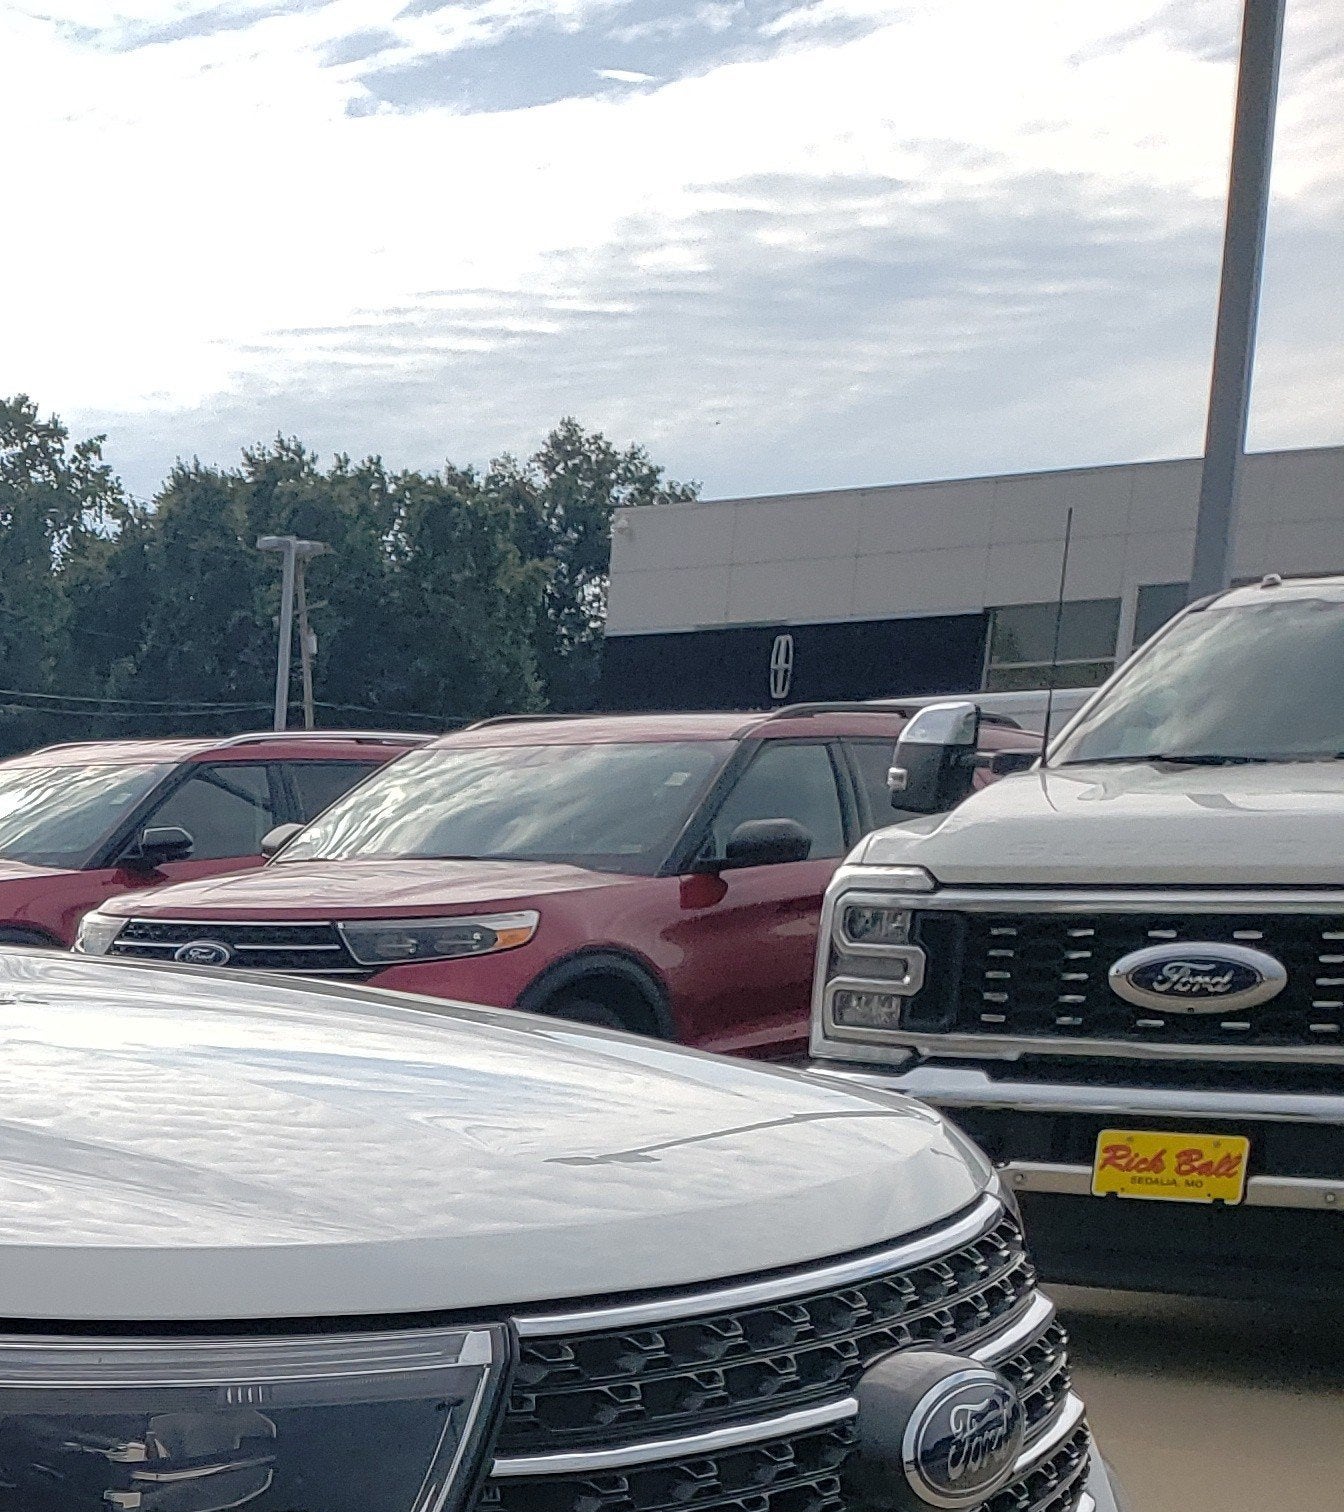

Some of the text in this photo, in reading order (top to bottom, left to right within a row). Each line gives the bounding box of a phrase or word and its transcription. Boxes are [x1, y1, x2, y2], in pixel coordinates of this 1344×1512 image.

[1152, 961, 1235, 993] Ford
[1100, 1145, 1242, 1178] Rick Ball
[947, 1398, 1009, 1481] Ford
